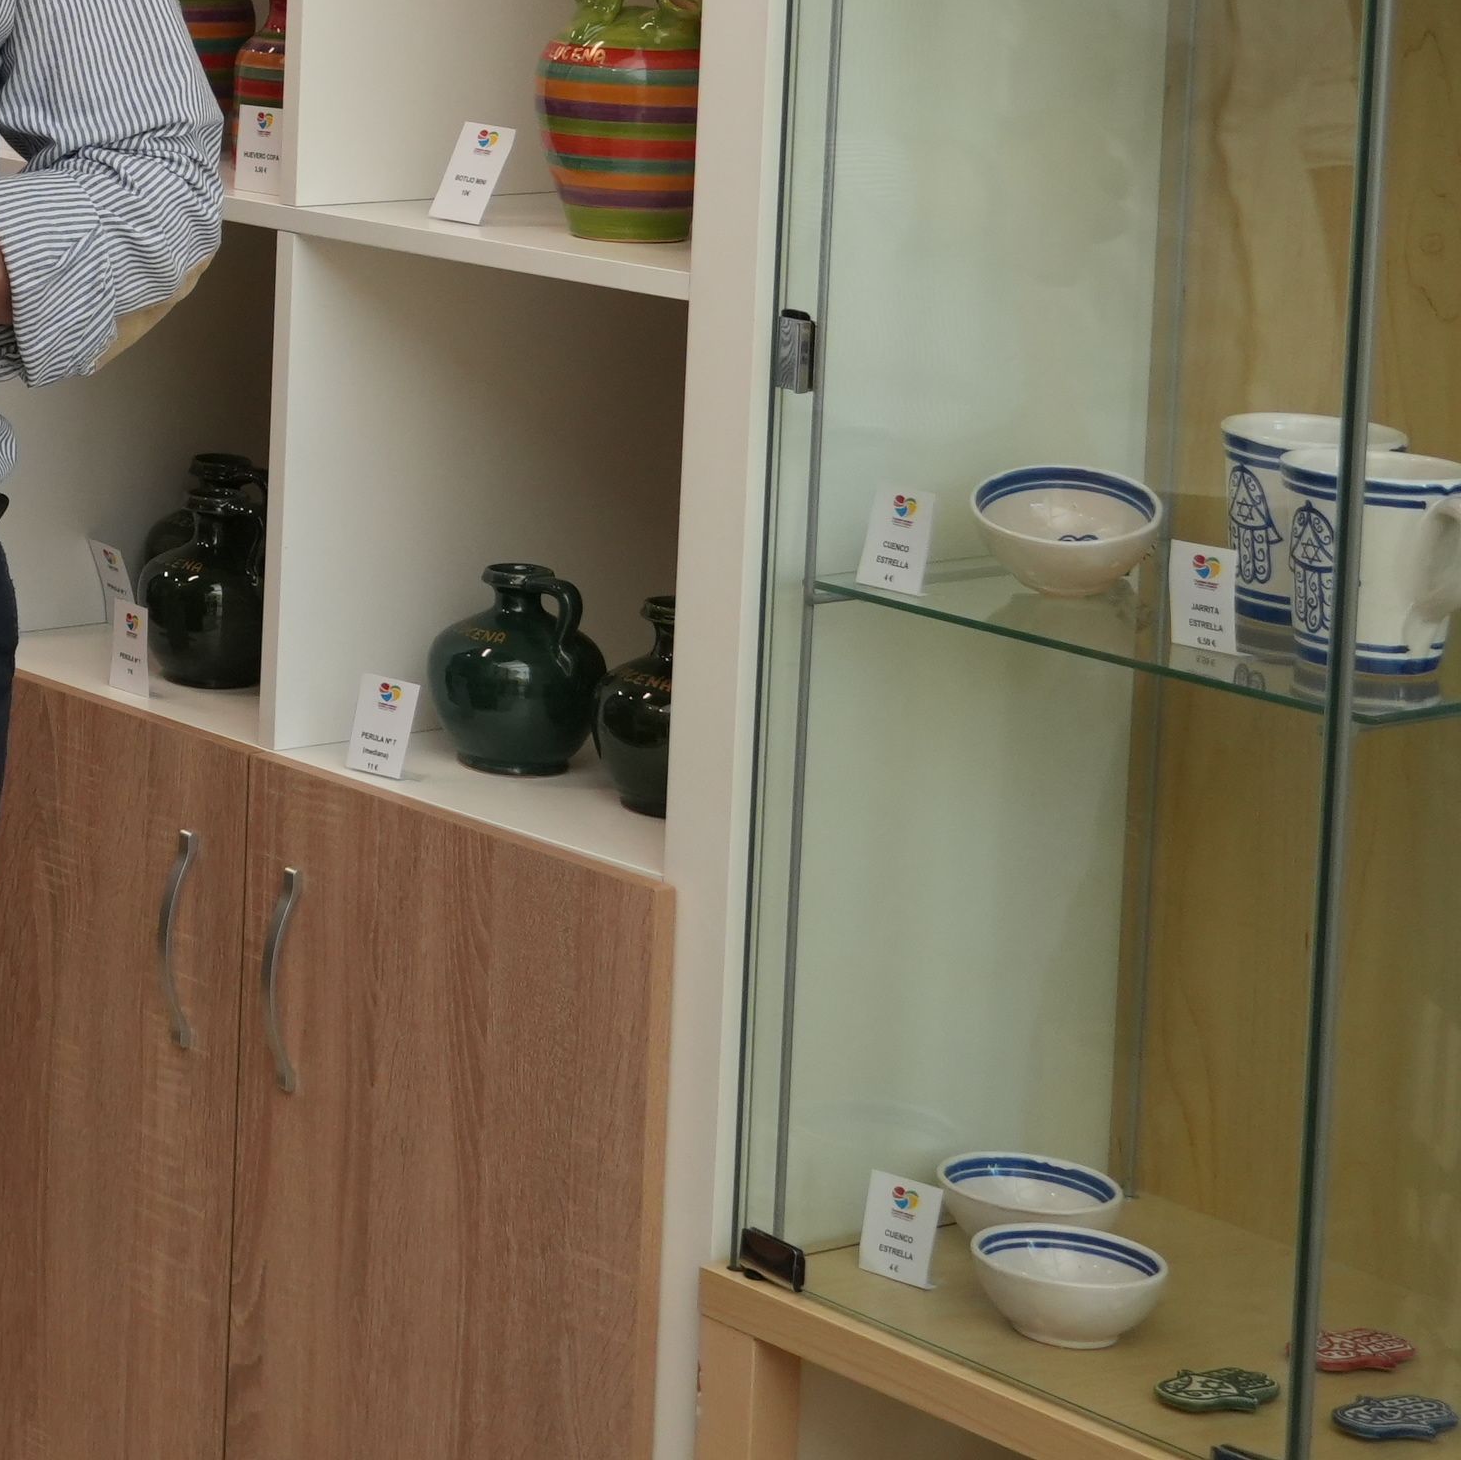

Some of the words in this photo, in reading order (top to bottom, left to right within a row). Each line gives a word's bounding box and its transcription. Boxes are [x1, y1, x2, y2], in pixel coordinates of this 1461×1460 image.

[882, 540, 910, 554] CUENCO
[875, 554, 910, 571] ESTRELLA
[1190, 602, 1220, 617] JARRITA
[1188, 618, 1223, 634] ESTRELLA
[361, 730, 384, 744] PERULA
[884, 1229, 914, 1244] CUENCO
[878, 1243, 914, 1261] ESTRELLA
